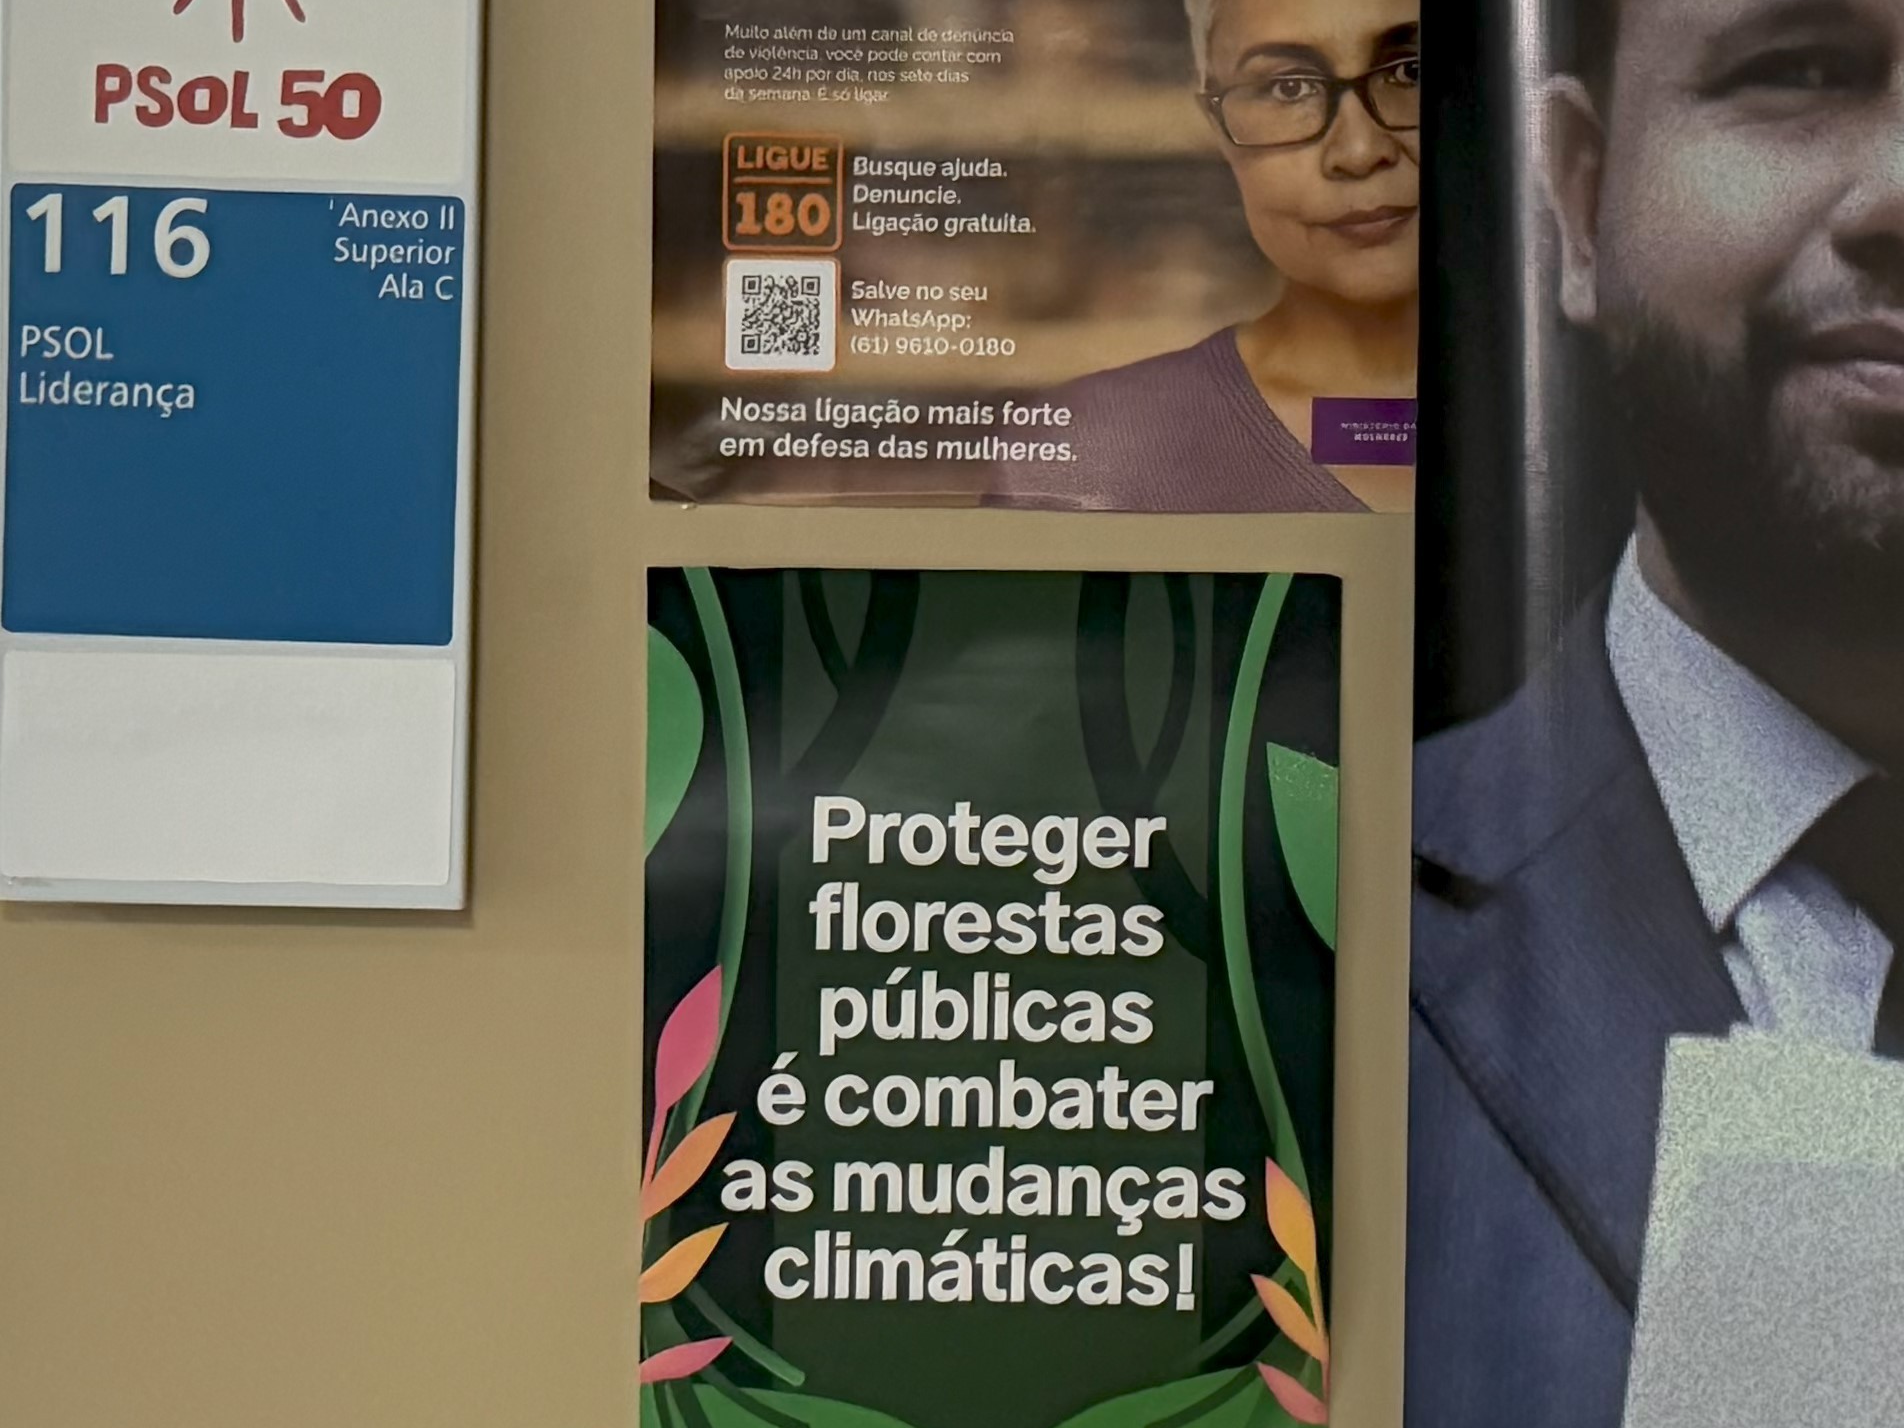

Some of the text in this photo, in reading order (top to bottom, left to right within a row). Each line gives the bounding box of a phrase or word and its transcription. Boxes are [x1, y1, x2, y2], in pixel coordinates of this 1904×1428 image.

[842, 30, 866, 42] um
[871, 28, 913, 43] canal
[918, 28, 938, 42] de
[868, 48, 908, 63] pode
[967, 50, 1001, 63] com
[772, 66, 802, 81] 24h
[806, 68, 832, 82] por
[867, 69, 895, 82] nos
[937, 68, 970, 83] dias
[277, 69, 382, 140] 50
[737, 145, 829, 170] LIGUE
[852, 156, 1007, 181] Busque ajuda.
[852, 184, 961, 205] Denuncie.
[338, 201, 454, 229] Anexo II
[735, 192, 832, 236] 180
[852, 211, 1036, 237] Ligação gratuita.
[26, 192, 210, 279] 116
[333, 236, 456, 269] Superior
[377, 273, 454, 300] Ala C
[851, 280, 987, 301] Salve no seu
[851, 308, 971, 332] WhatsApp:
[19, 324, 114, 360] PSOL
[850, 336, 1015, 356] (61) 9610-0180
[19, 372, 196, 418] Liderança
[720, 397, 1072, 428] Nossa ligação mais forte
[719, 433, 1077, 461] em defesa das mulheres.
[812, 795, 1166, 885] Proteger
[808, 882, 1165, 957] florestas
[819, 966, 1154, 1057] públicas
[756, 1052, 1214, 1131] é combater
[720, 1146, 1246, 1236] as mudanças
[764, 1228, 1196, 1311] climáticas!
